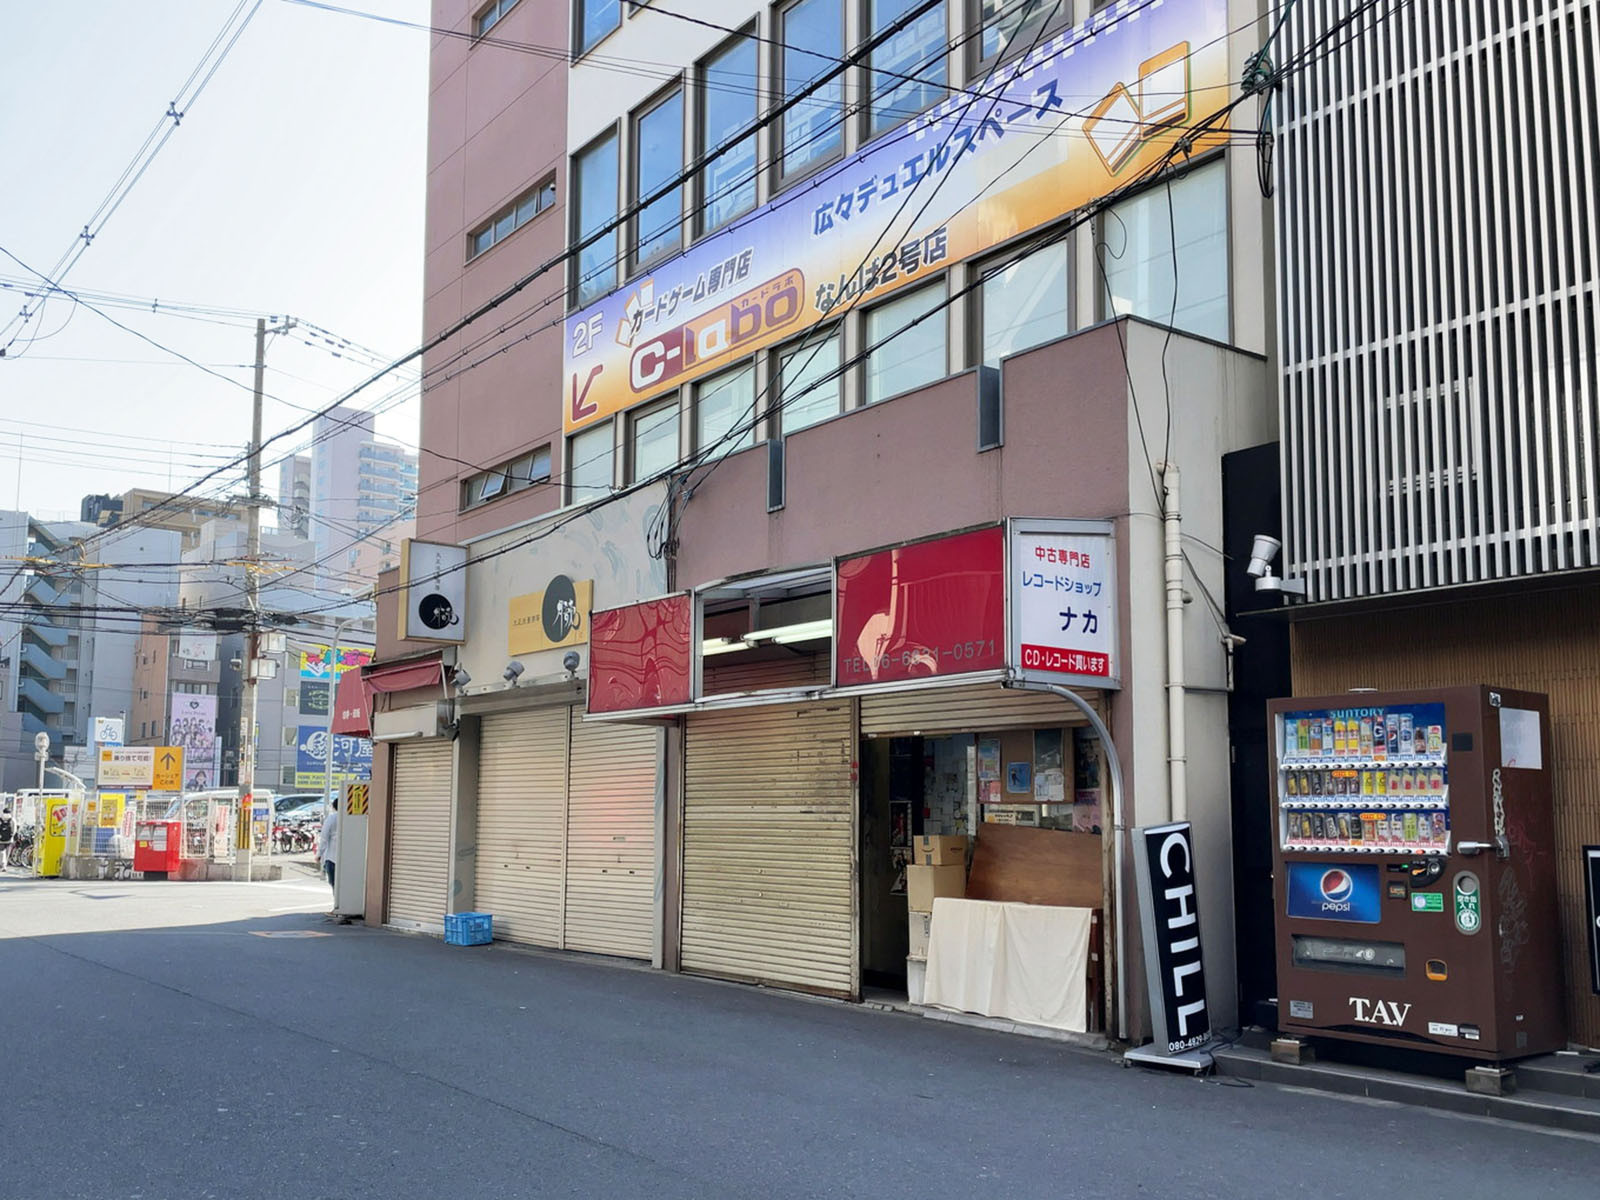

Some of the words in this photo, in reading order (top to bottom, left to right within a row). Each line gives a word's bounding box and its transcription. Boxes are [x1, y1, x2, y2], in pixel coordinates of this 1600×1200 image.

[812, 79, 1063, 237] 広々デュエルスペース
[814, 227, 948, 312] なんば2号店
[630, 247, 754, 336] カードゲーム専門店
[740, 274, 795, 306] カードラボ
[572, 312, 604, 357] 2F
[632, 288, 799, 388] C-labo
[1035, 546, 1090, 569] 中古専門店
[1022, 570, 1102, 597] レコードショップ
[1059, 606, 1098, 634] ナカ
[1024, 649, 1105, 674] CD・レコード買います
[1330, 708, 1385, 719] SUNTORY
[1321, 901, 1351, 913] pepsi
[1160, 832, 1206, 1037] CHILL
